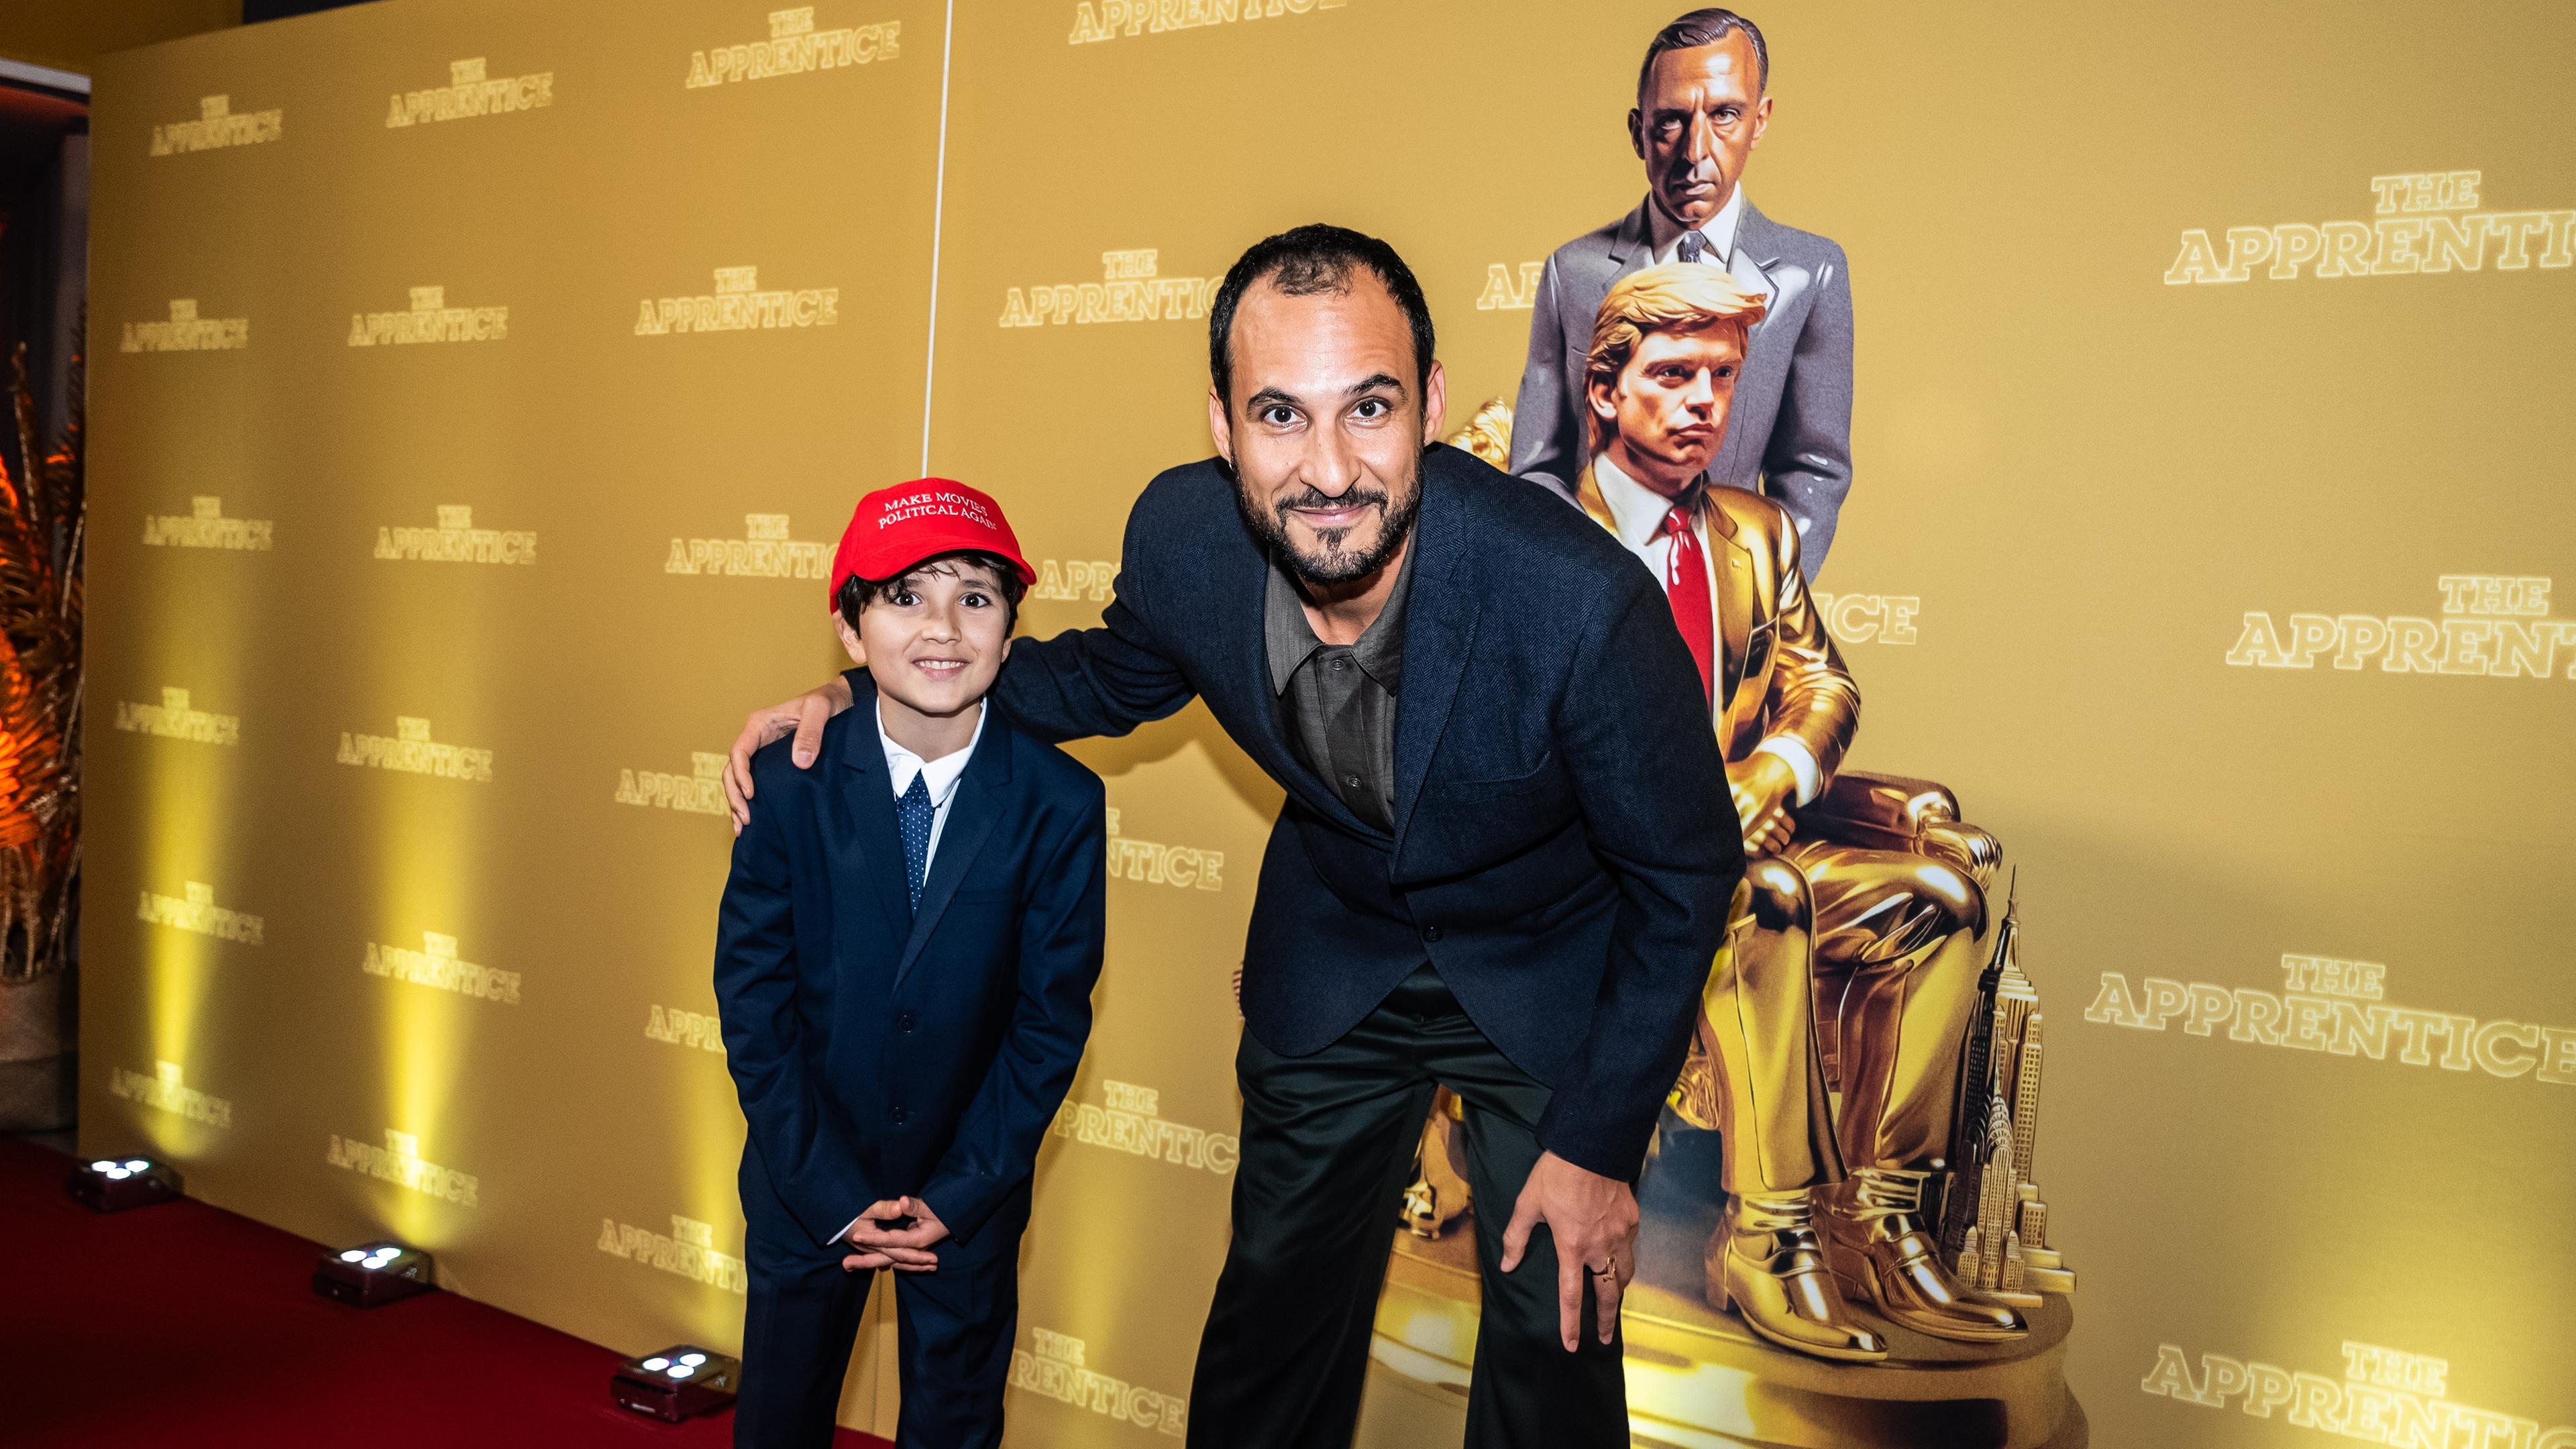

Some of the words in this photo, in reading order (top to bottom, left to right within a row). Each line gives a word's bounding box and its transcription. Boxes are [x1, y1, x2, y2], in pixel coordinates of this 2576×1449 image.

[769, 6, 814, 37] THE
[686, 21, 901, 89] APPRENTICE
[386, 72, 553, 128] APPRENTICE
[2371, 170, 2481, 214] THE
[714, 265, 757, 293] THE
[1102, 248, 1158, 280] THE
[347, 306, 508, 347] APPRENTICE
[635, 288, 839, 335] APPRENTICE
[878, 504, 959, 529] POLITICAL
[961, 508, 997, 531] AGAIN
[885, 494, 932, 512] MAKE
[935, 492, 987, 517] MOVIES
[374, 527, 537, 565] APPRENTICE
[746, 513, 790, 539] THE
[2438, 575, 2551, 616] THE
[337, 732, 493, 783] APPRENTICE
[362, 943, 522, 1005] APPRENTICE
[2282, 953, 2385, 1000] THE
[2084, 971, 2576, 1086] APPRENTICE
[1104, 1079, 1159, 1116] THE
[327, 1134, 478, 1208] APPRENTICE
[672, 1214, 712, 1247] THE
[1032, 1326, 1085, 1366] THE
[2341, 1340, 2448, 1397] THE
[2141, 1344, 2576, 1449] APPRENTI
